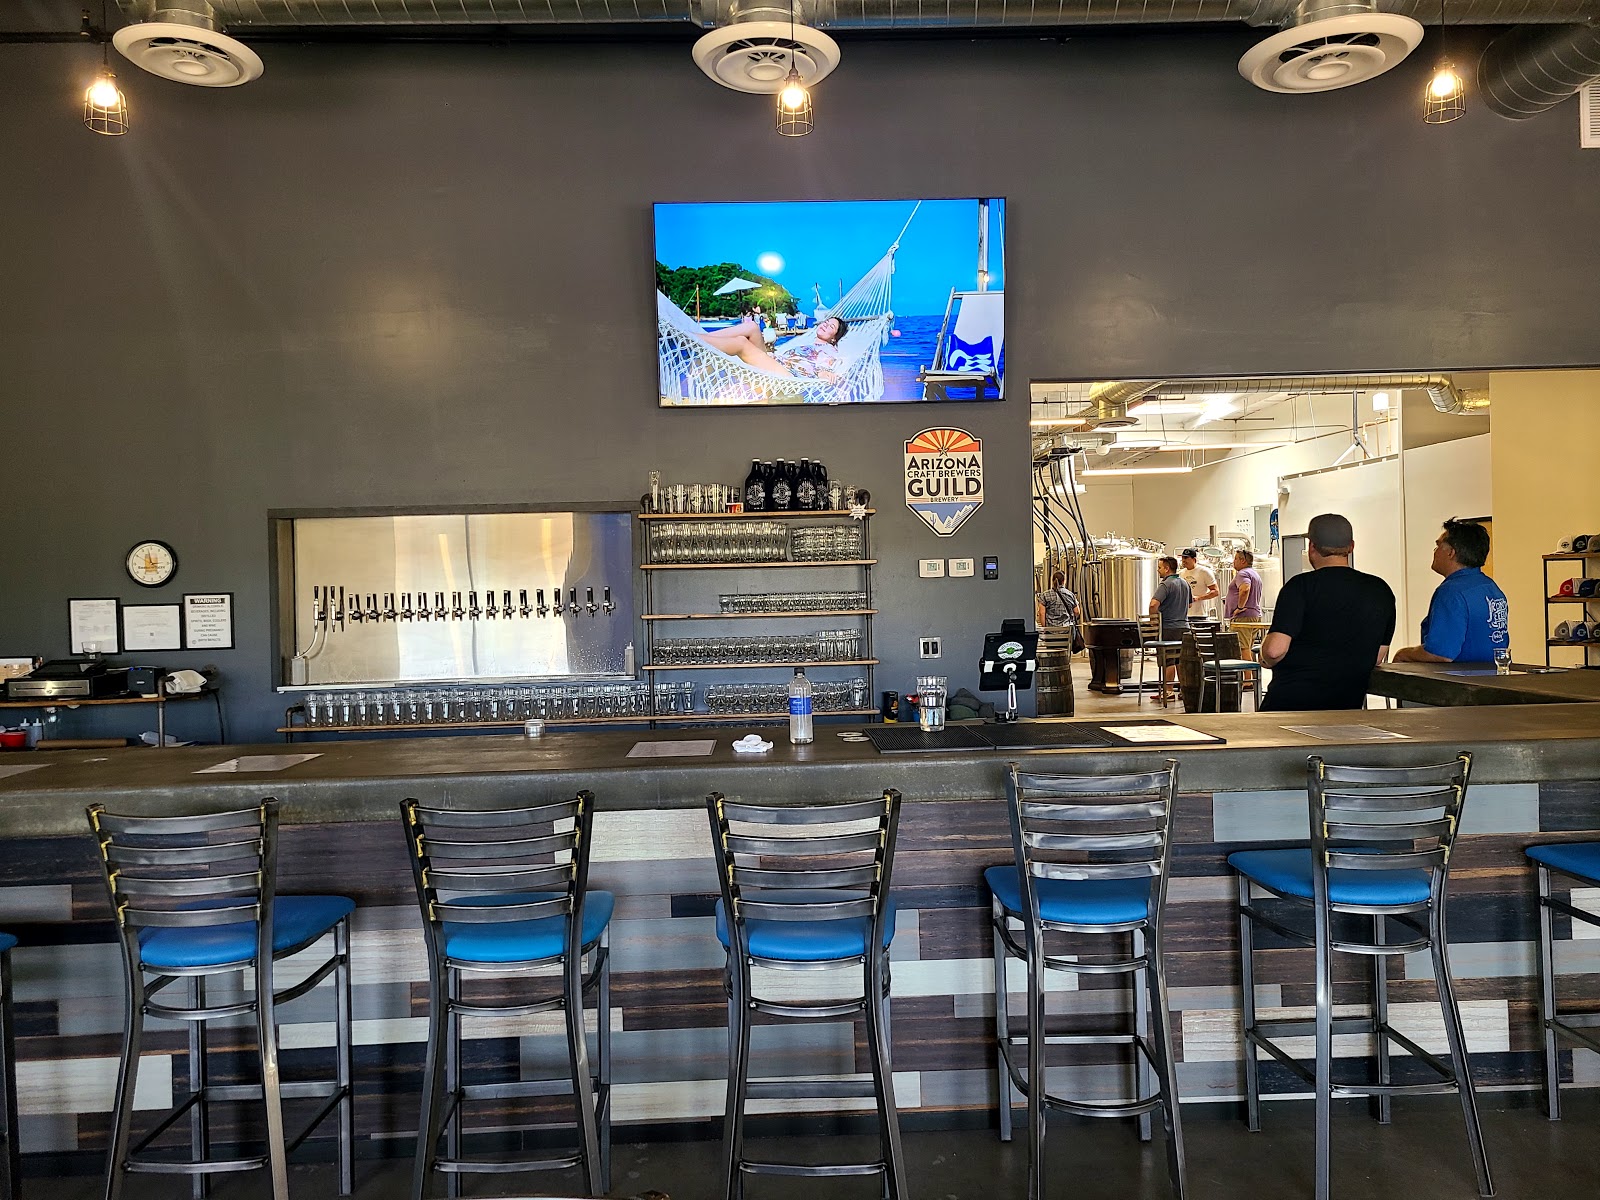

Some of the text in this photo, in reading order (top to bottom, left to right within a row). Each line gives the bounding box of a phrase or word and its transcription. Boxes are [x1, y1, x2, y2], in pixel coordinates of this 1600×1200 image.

[907, 454, 980, 470] ARIZONA
[907, 469, 981, 478] CRAFT BREWERS
[907, 477, 981, 497] GUILD
